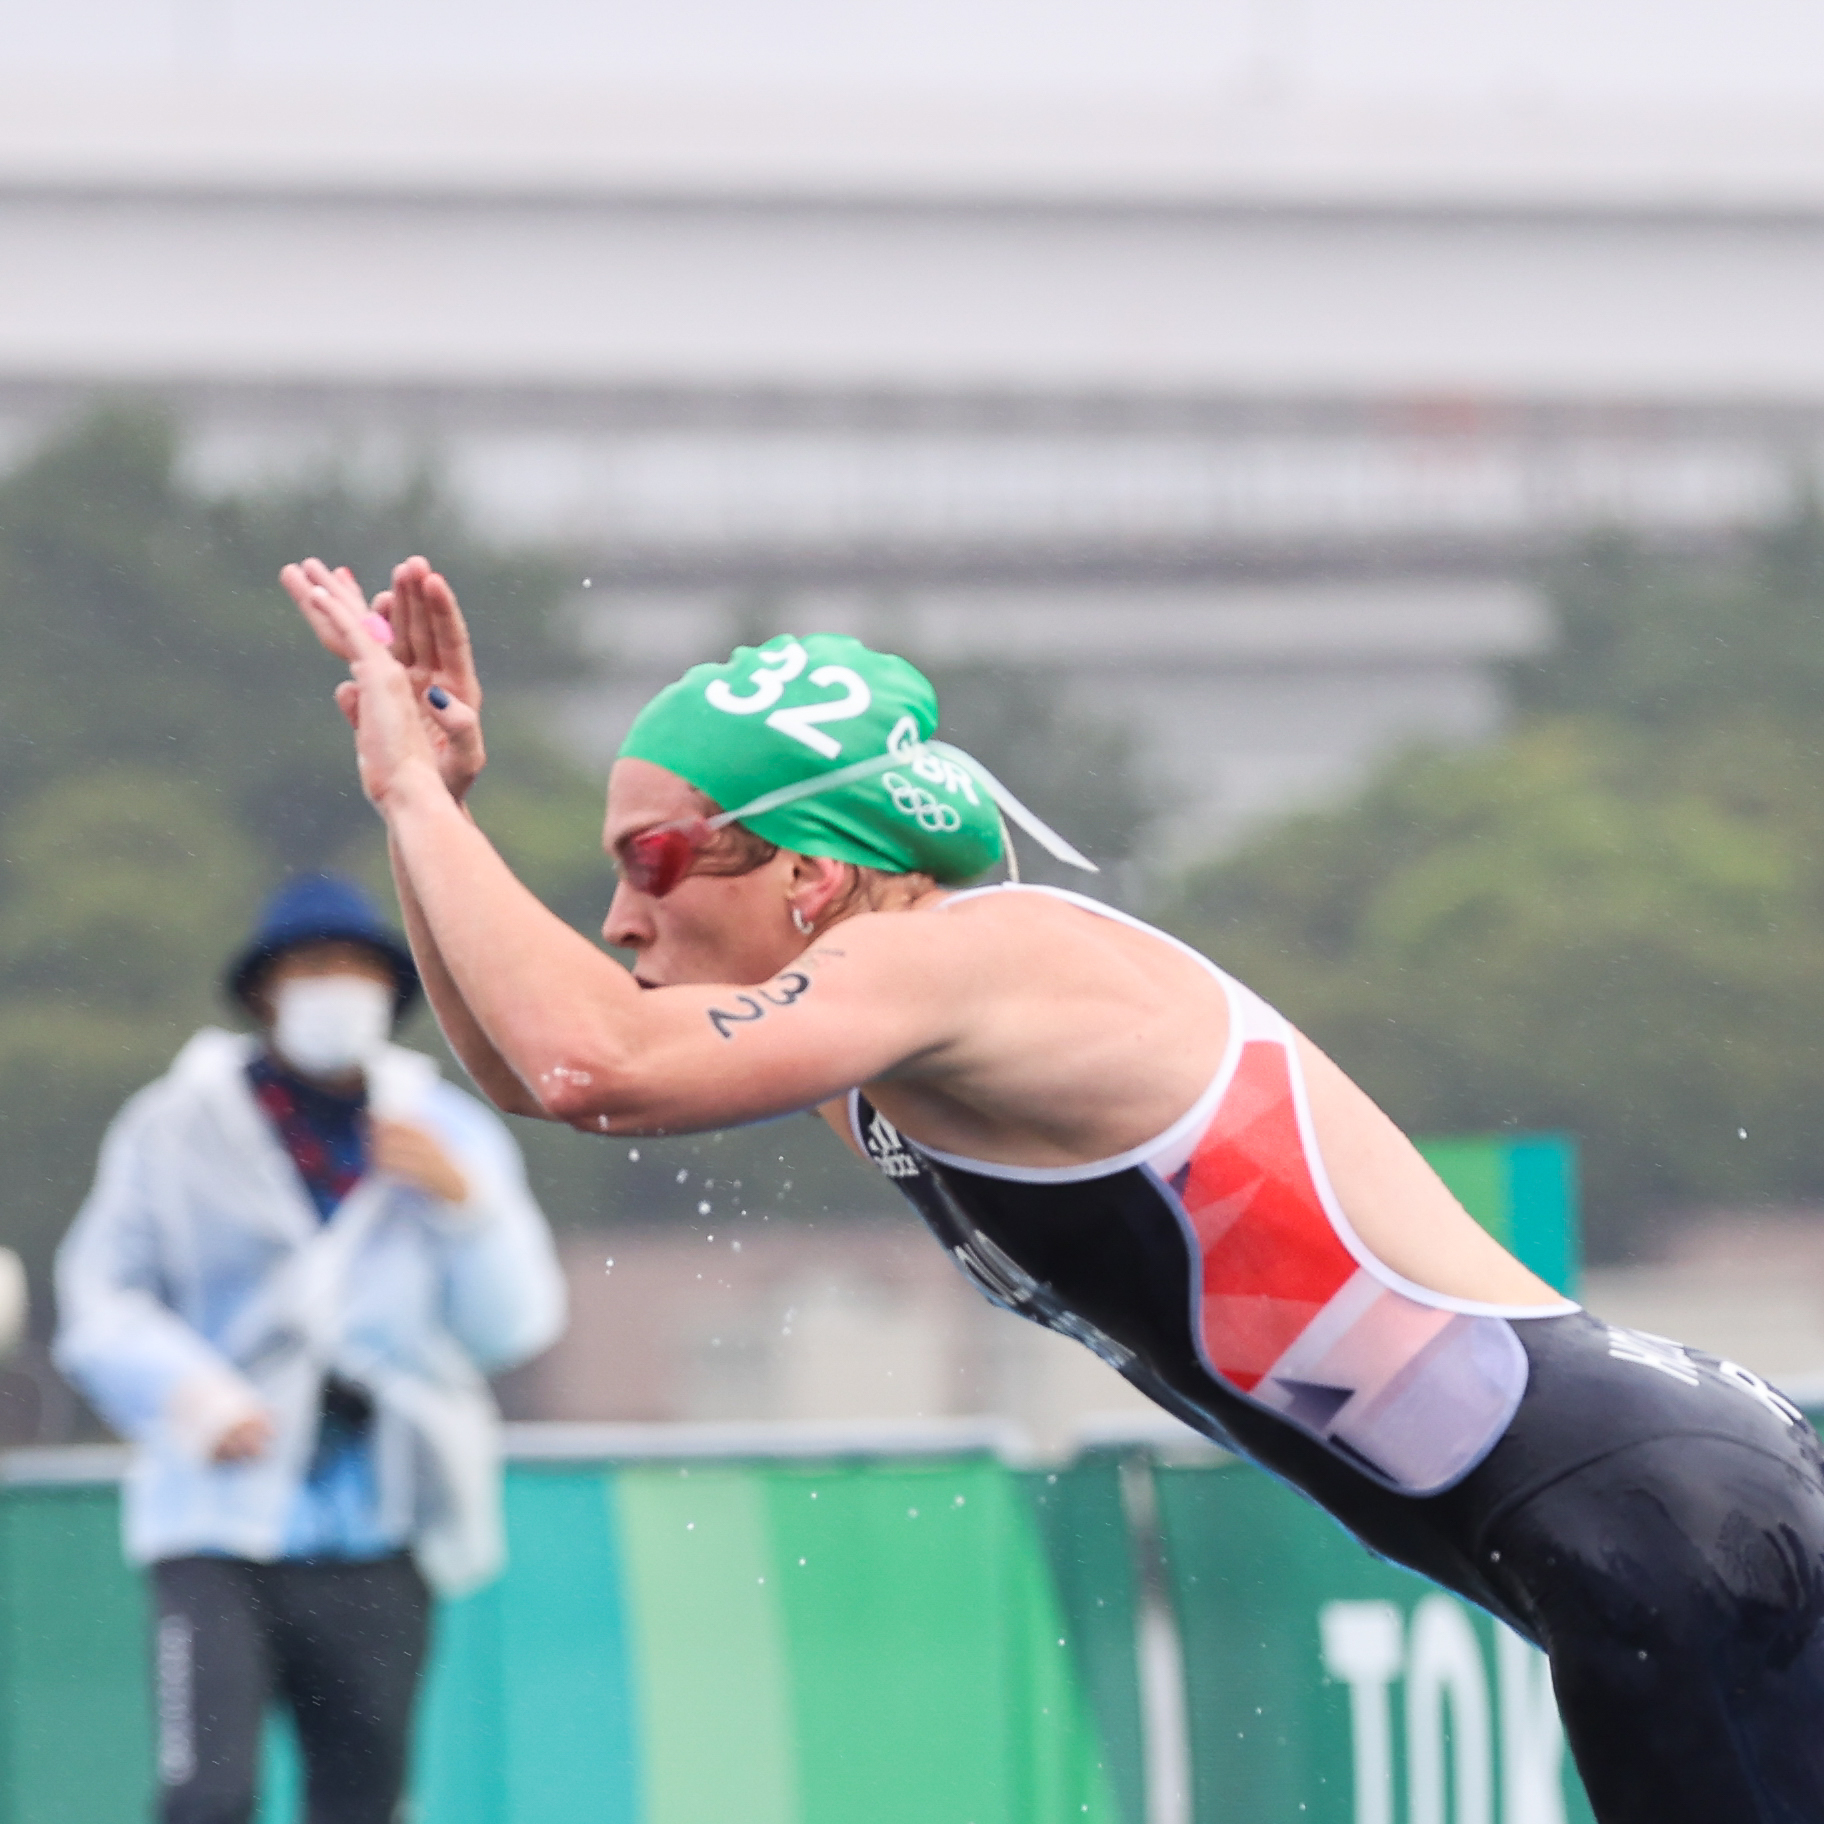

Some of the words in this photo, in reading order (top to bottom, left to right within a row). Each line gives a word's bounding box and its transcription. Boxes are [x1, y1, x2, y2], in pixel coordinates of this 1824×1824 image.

[704, 642, 872, 761] 32
[886, 715, 980, 807] GBR
[707, 971, 810, 1039] 32
